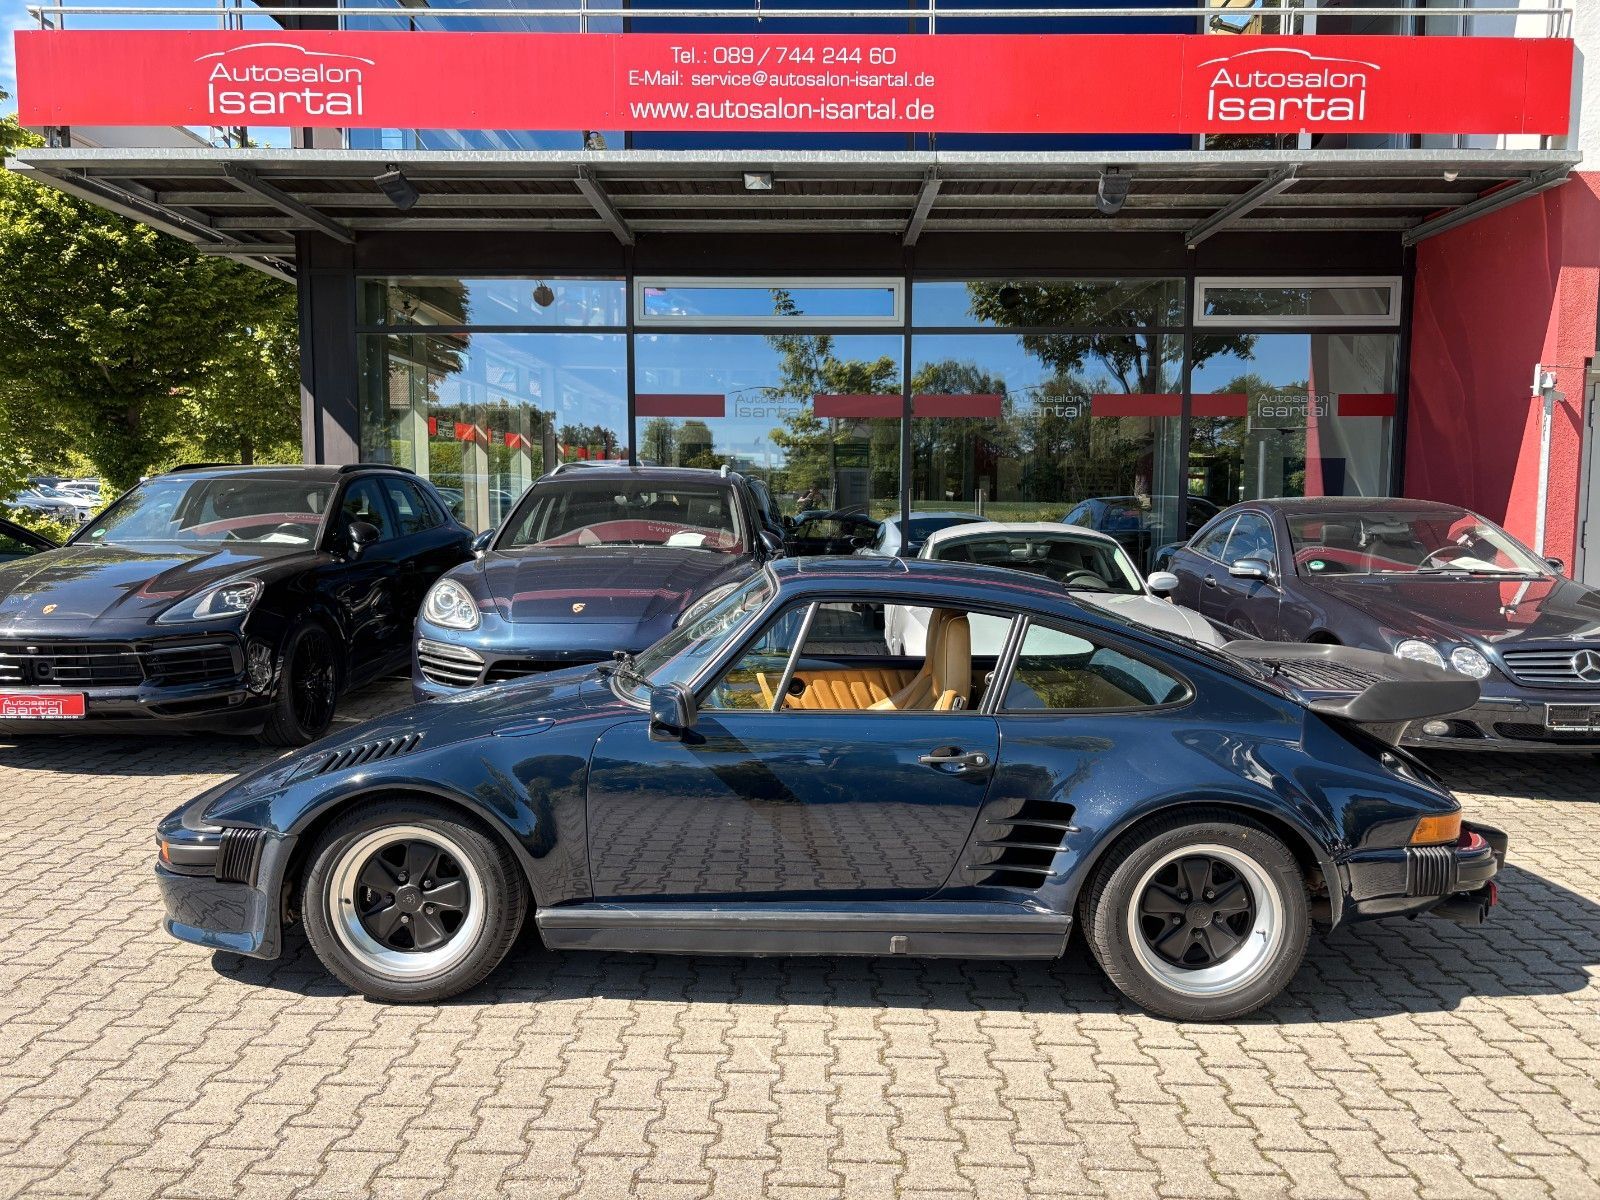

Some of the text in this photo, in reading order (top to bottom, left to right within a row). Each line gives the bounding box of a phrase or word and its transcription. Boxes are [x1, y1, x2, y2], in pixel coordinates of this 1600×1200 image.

[714, 47, 753, 64] 089
[776, 48, 815, 64] 744
[823, 48, 861, 64] 244
[870, 48, 896, 65] 60
[209, 63, 361, 83] Autosalon
[629, 70, 935, 87] E-Mail: service@autosalon-isartal.de
[1211, 68, 1365, 88] Autosalon
[208, 83, 362, 115] Isartal
[629, 98, 935, 120] www.autosalon-isartal.de
[1208, 90, 1365, 121] Isartal
[1258, 393, 1328, 402] Autosalon
[1257, 403, 1328, 417] Isartal
